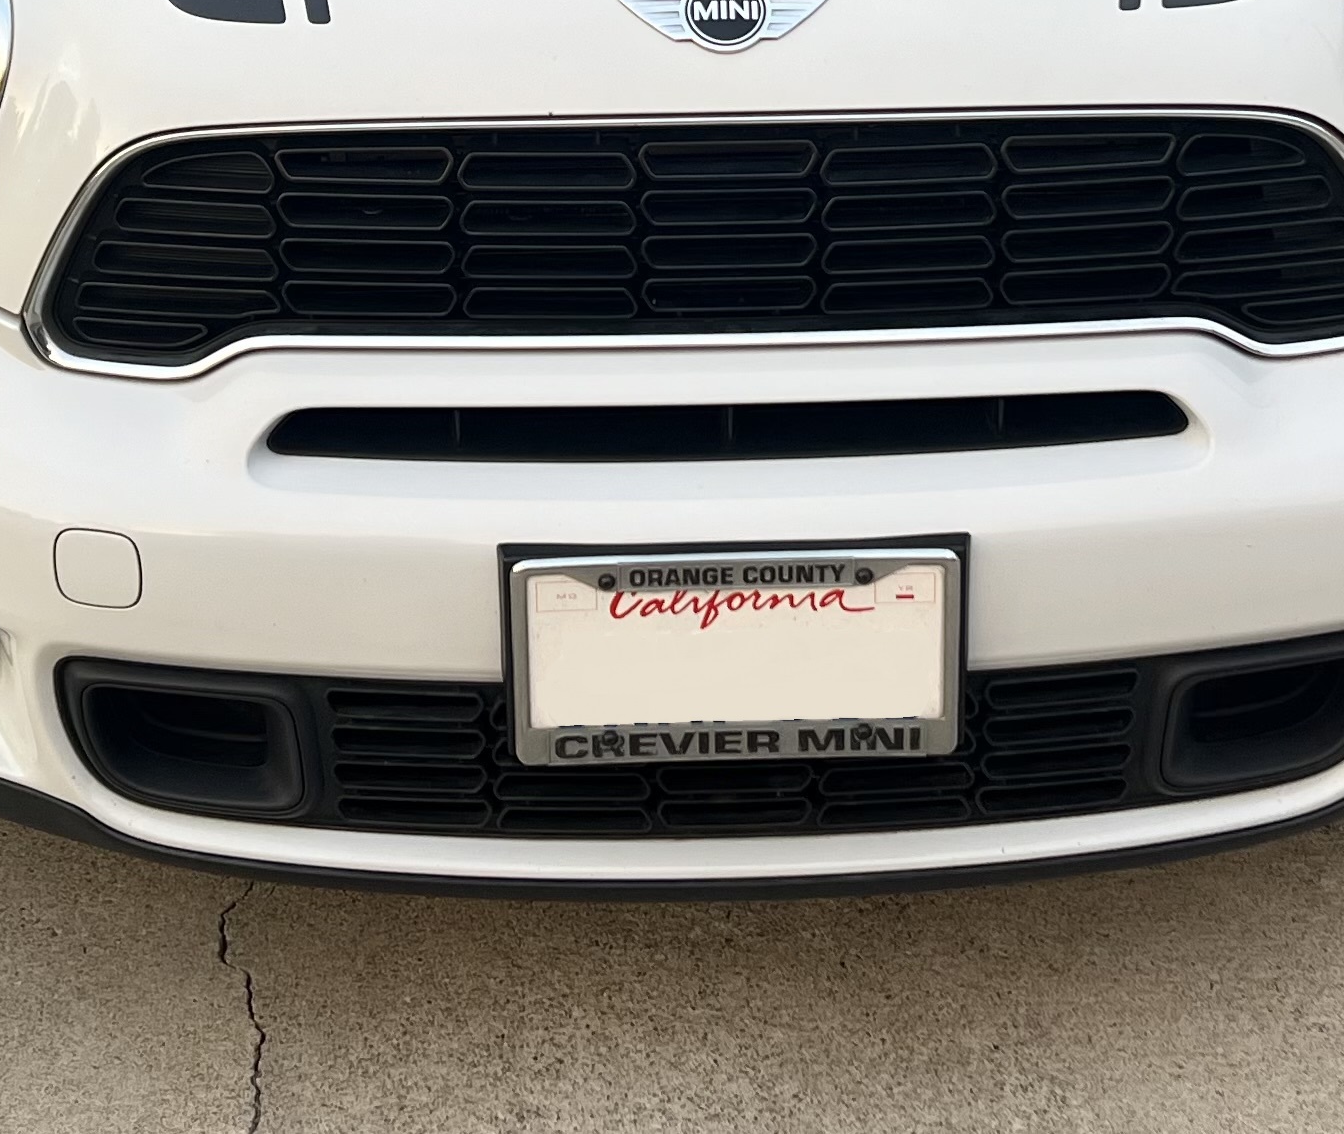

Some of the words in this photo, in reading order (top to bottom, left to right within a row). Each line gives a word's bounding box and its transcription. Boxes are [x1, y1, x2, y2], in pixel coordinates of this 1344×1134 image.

[693, 0, 759, 21] MINI
[629, 567, 733, 586] ORANGE
[742, 564, 845, 584] COUNTY
[609, 589, 875, 629] California
[555, 730, 780, 759] CREVIER
[798, 727, 920, 751] MINI
